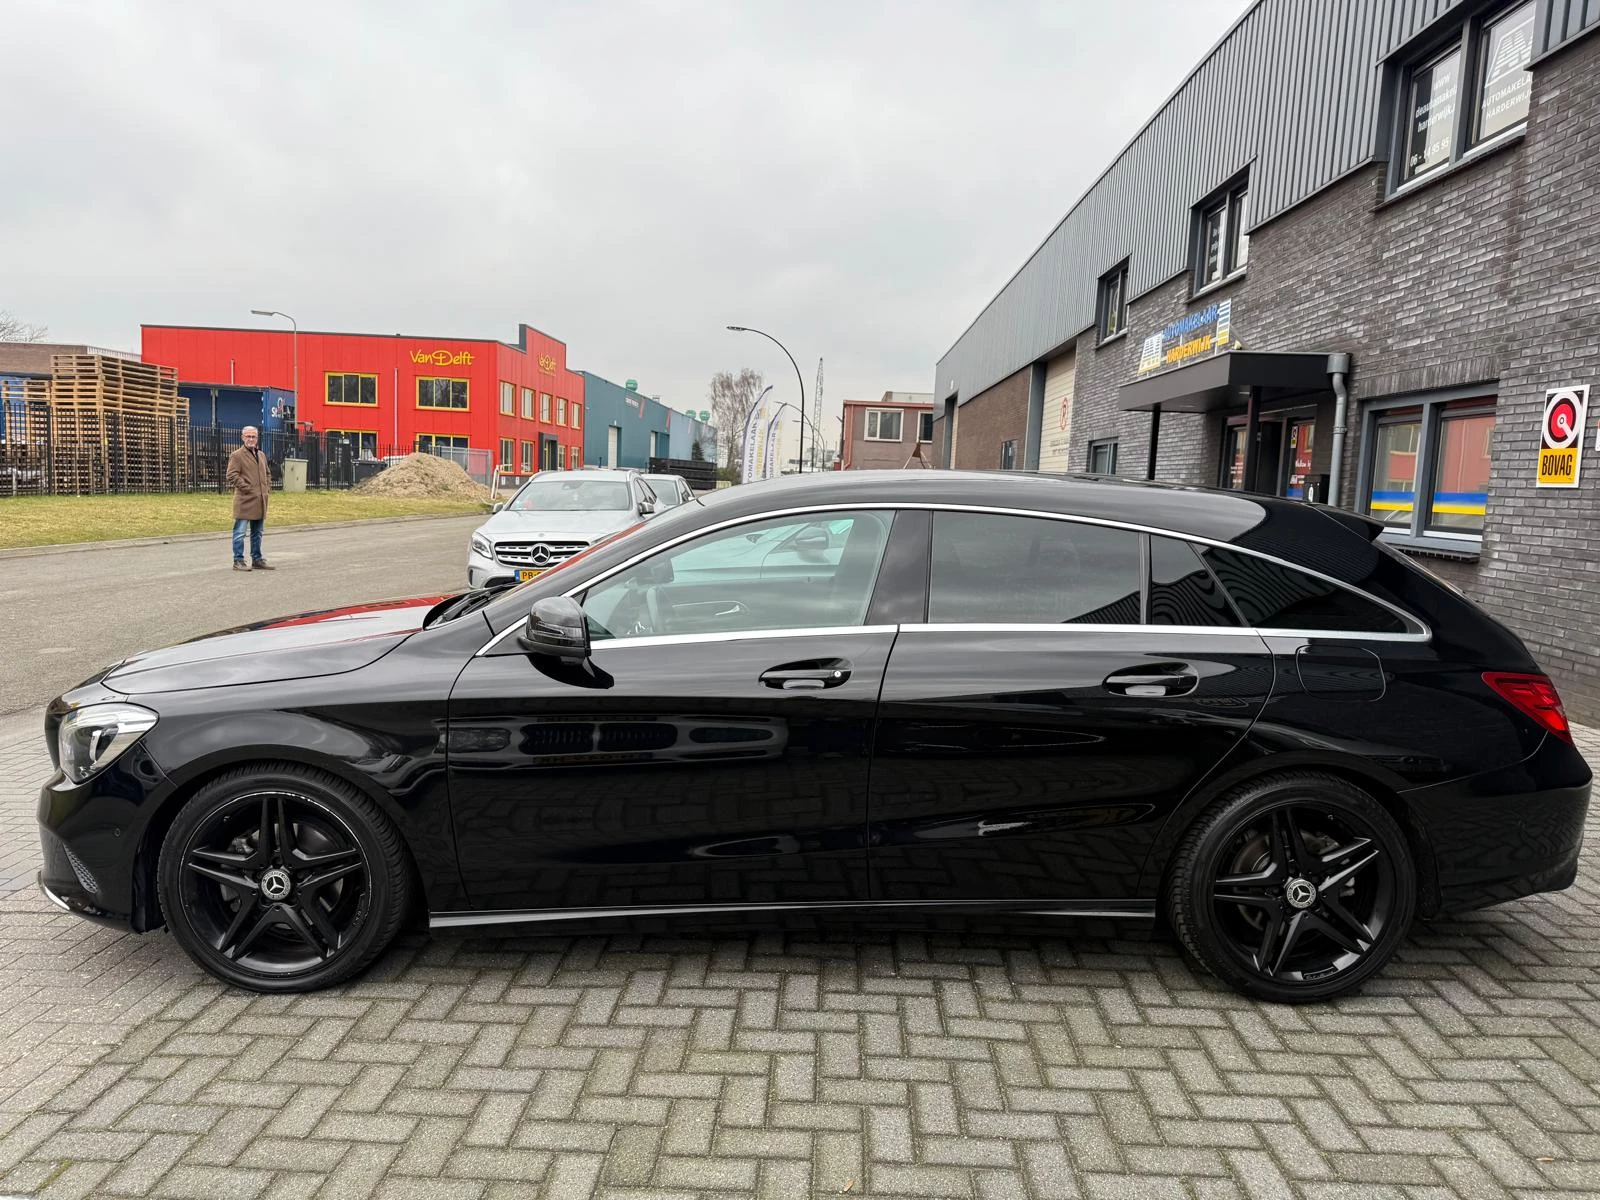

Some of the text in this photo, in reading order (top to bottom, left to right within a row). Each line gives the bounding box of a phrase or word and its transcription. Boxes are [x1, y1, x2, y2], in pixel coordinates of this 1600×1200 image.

[1486, 89, 1532, 120] HARDERWIJ
[1163, 304, 1219, 340] AUTOMAKELAAR
[409, 348, 476, 366] Van Delft
[1166, 335, 1211, 364] HARDERWIJK
[1541, 454, 1573, 476] BOVAG
